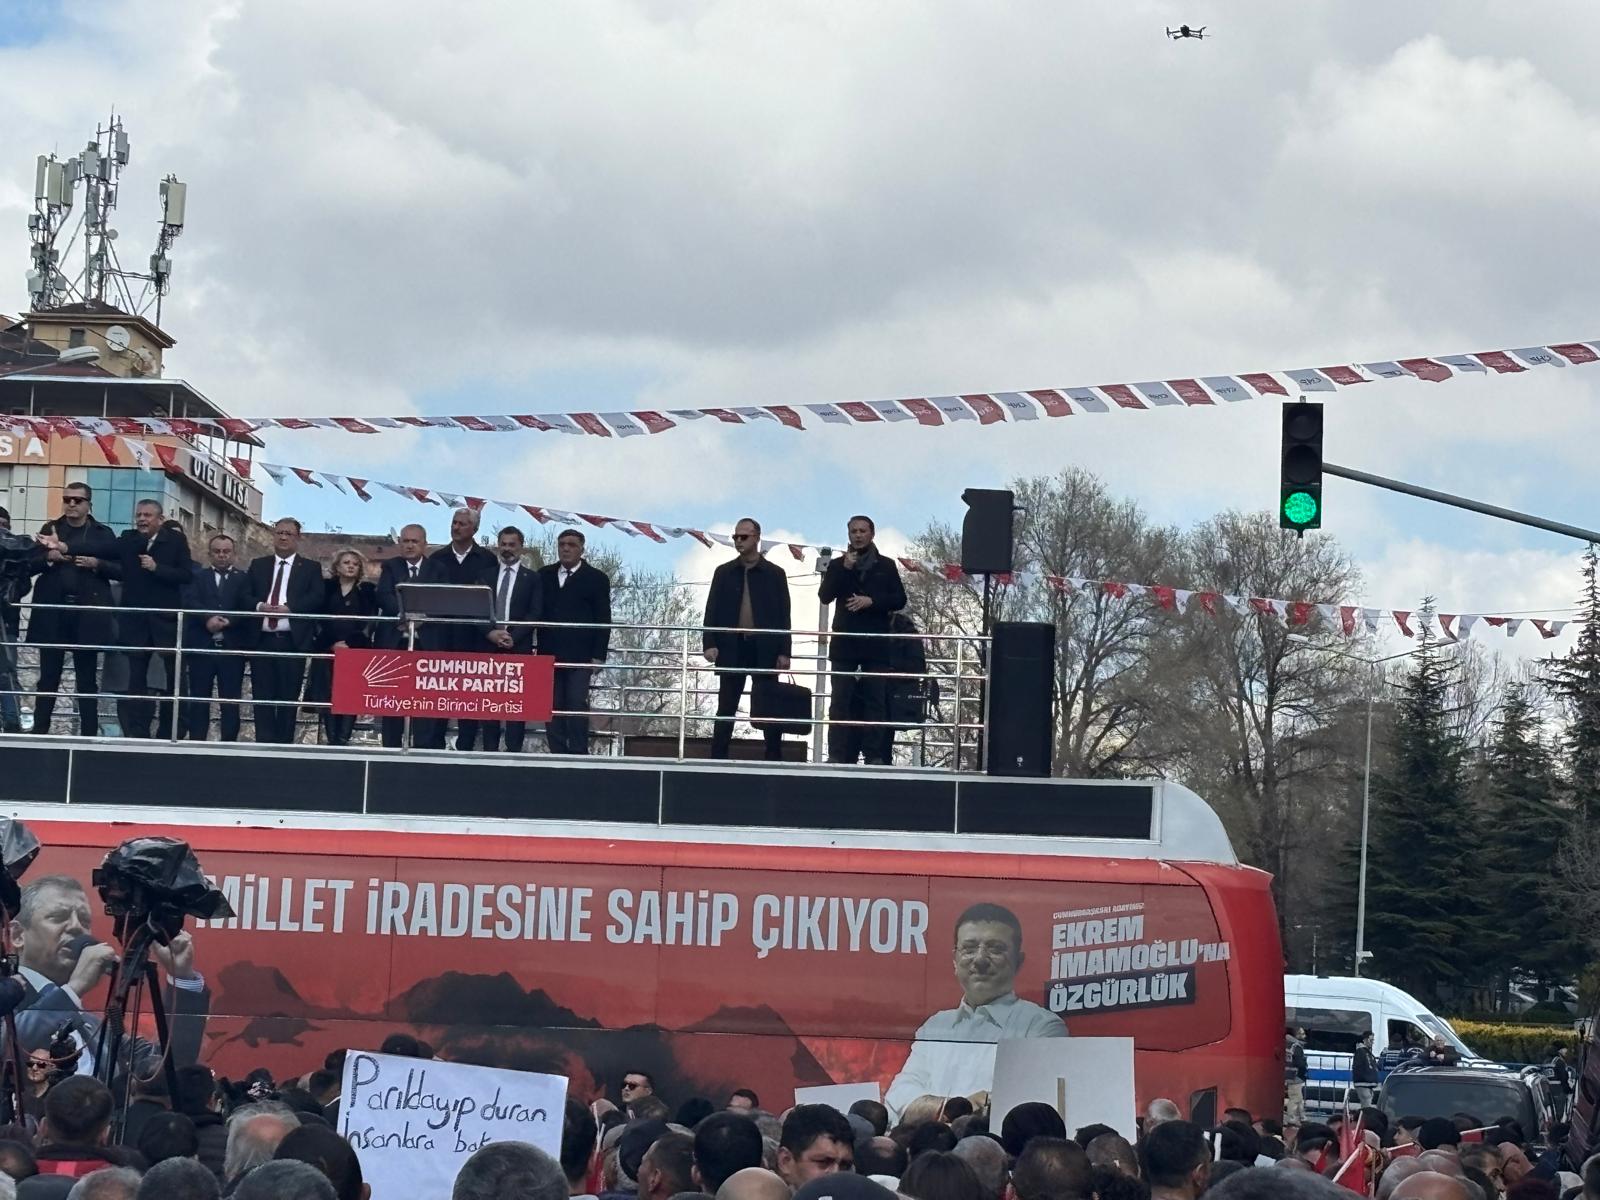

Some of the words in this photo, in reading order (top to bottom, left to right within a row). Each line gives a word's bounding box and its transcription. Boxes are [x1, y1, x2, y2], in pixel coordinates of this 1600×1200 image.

[415, 676, 458, 691] HALK
[462, 675, 524, 693] PARTİSİ
[416, 657, 525, 676] CUMHURİYET
[362, 694, 434, 711] Türkiye'nin
[437, 696, 478, 712] Birinci
[481, 698, 523, 713] Partisi
[366, 878, 593, 942] İRADESİNE
[606, 888, 739, 947] SAHİP
[752, 893, 929, 959] ÇIKIYOR
[1052, 914, 1144, 950] EKREM
[1050, 939, 1230, 980] İMAMOĞLU'NA
[1049, 972, 1189, 1013] ÖZGÜRLÜK
[479, 1087, 548, 1122] duran
